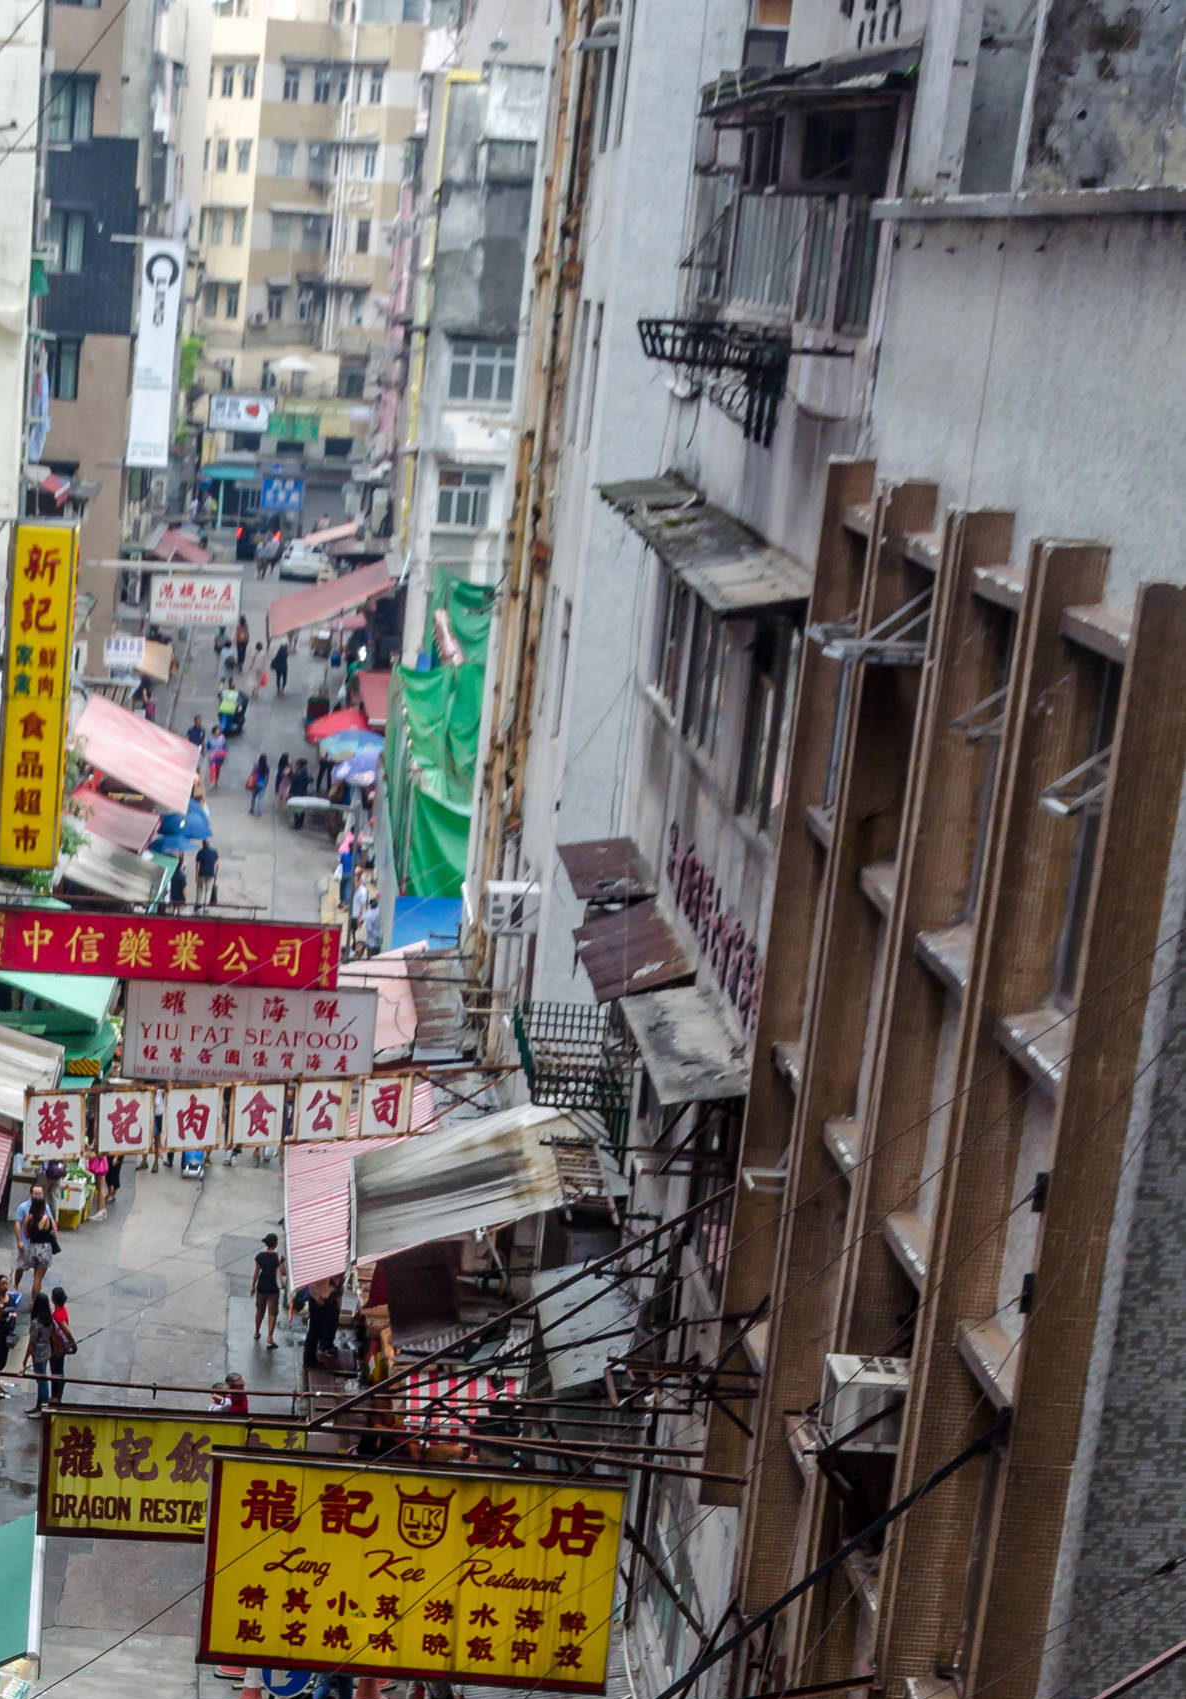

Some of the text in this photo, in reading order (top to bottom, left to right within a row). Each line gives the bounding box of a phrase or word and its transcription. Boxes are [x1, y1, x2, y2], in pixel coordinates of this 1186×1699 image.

[22, 544, 61, 632] 新記
[38, 646, 58, 698] 鮮肉
[12, 711, 47, 854] 食品超市
[22, 919, 303, 978] 中信藥業公司
[161, 989, 341, 1028] 耀發海鮮
[140, 1021, 359, 1051] YIU FAT SEAFOOD
[36, 1083, 403, 1149] 蘇記肉食公司
[52, 1493, 131, 1522] DRAGON
[403, 1504, 442, 1532] LK
[264, 1547, 567, 1595] Lung Kee Restaurant
